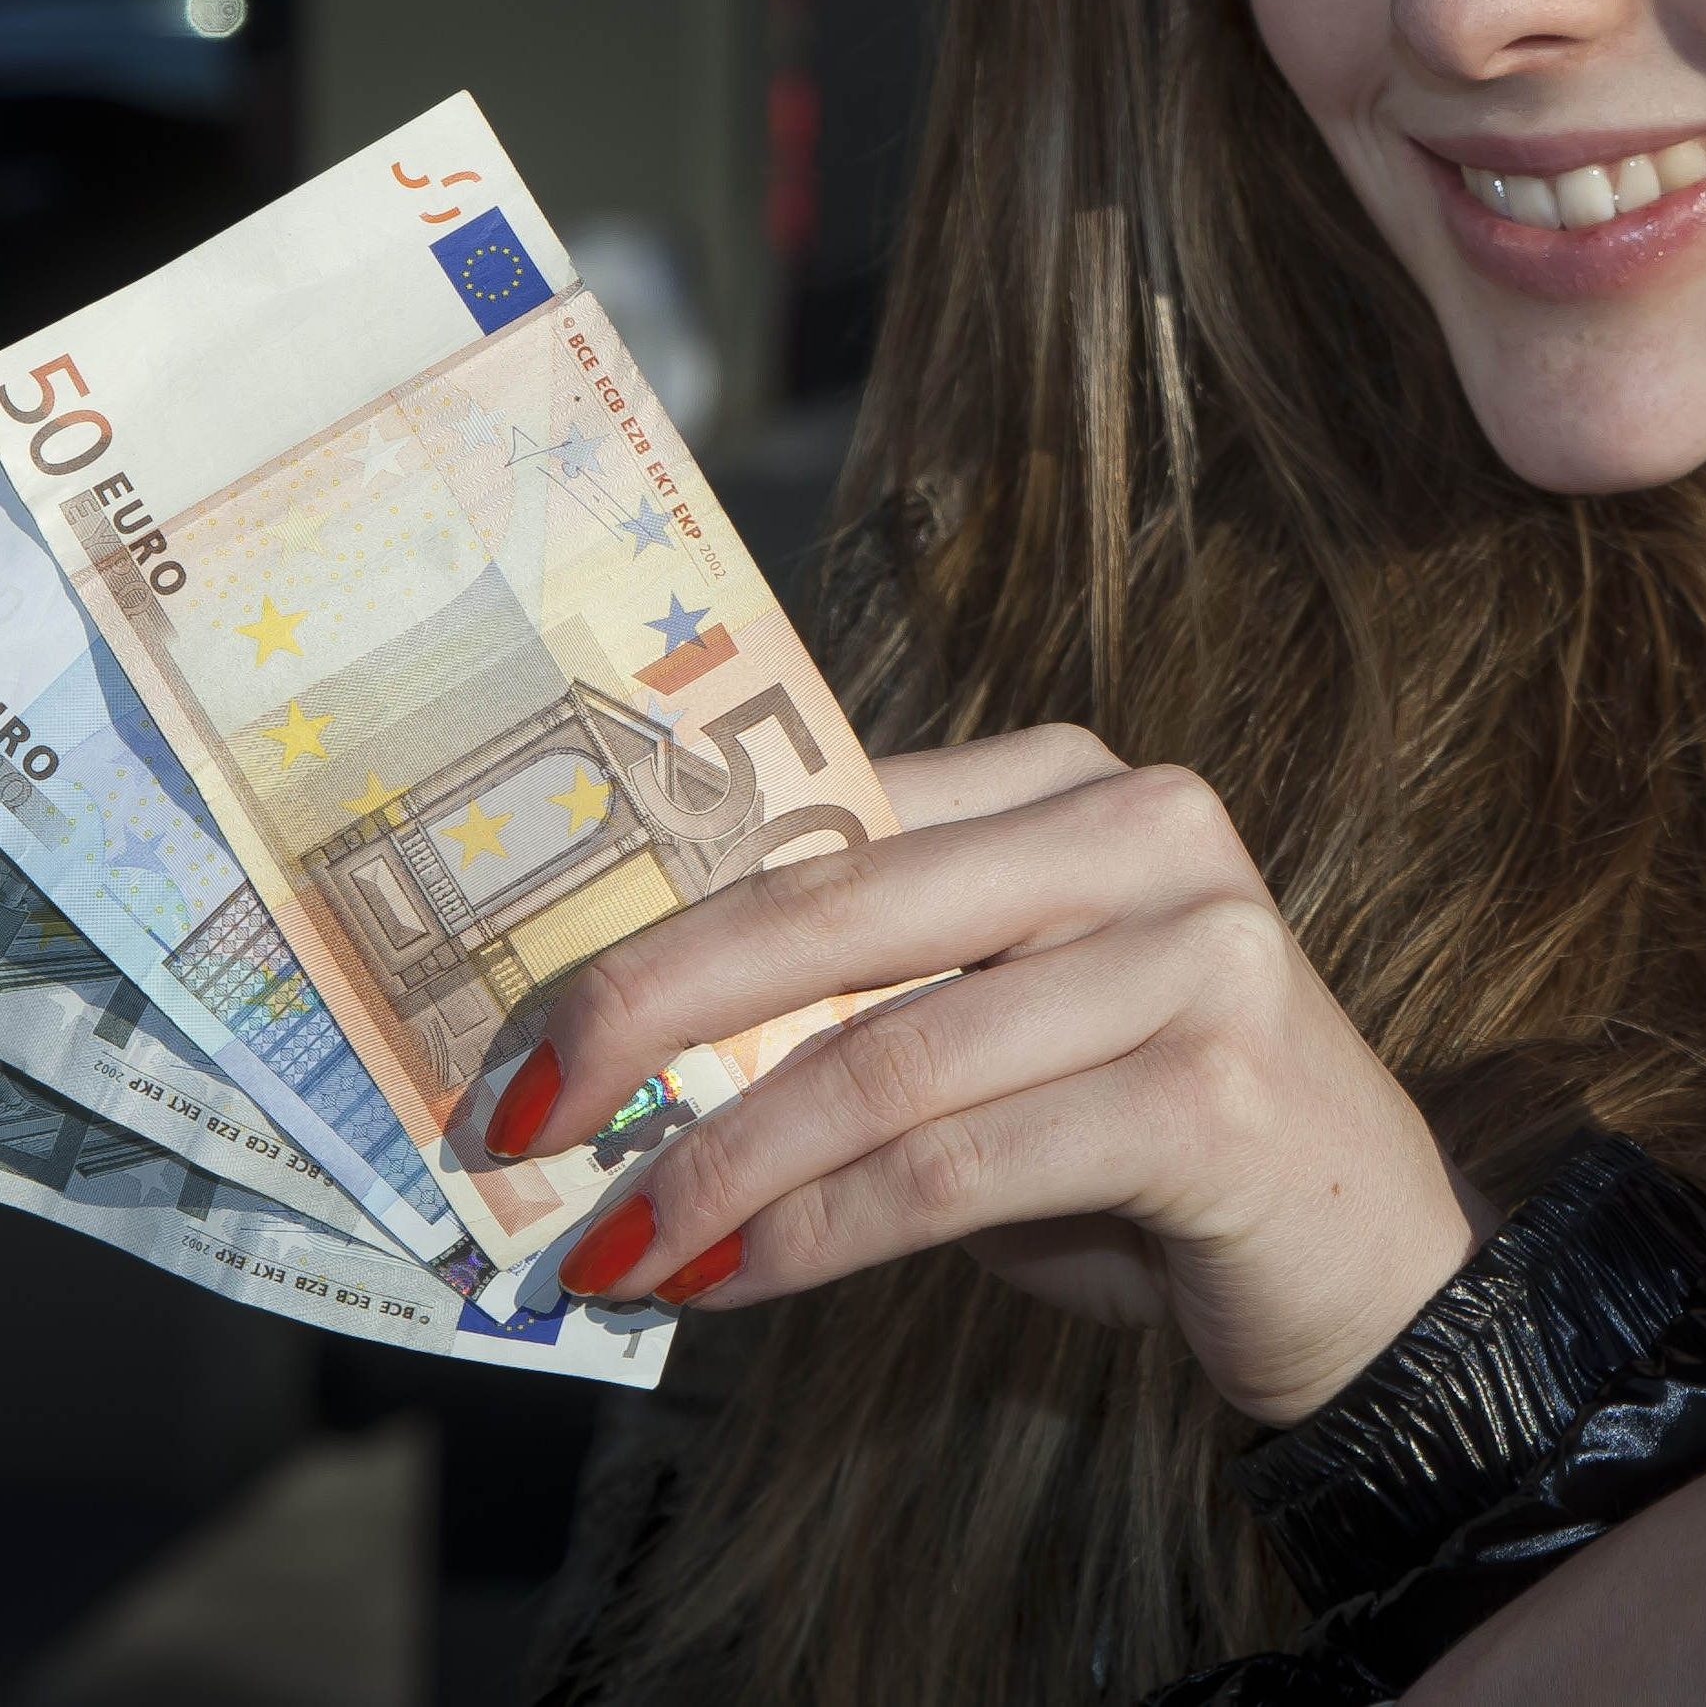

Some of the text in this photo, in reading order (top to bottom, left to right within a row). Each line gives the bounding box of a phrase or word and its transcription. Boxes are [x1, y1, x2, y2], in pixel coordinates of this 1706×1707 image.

[0, 353, 113, 476] 50
[567, 333, 600, 372] BCE
[593, 375, 625, 413] ECB
[620, 416, 652, 455] EZB
[646, 461, 679, 498] EKT
[672, 502, 703, 540] EKP
[699, 543, 727, 580] 2002
[92, 471, 187, 596] EURO
[0, 702, 59, 781] RO
[93, 1061, 125, 1083] 2002
[128, 1077, 164, 1102] EKP
[167, 1096, 201, 1122] EKT
[206, 1116, 240, 1142] EZB
[245, 1135, 279, 1160] ECB
[285, 1154, 321, 1180] BCE
[181, 1234, 210, 1255] 2002
[215, 1248, 246, 1270] EKP
[250, 1262, 286, 1284] EKT
[295, 1275, 328, 1297] EZB
[335, 1288, 371, 1310] ECB
[379, 1300, 415, 1320] BCE
